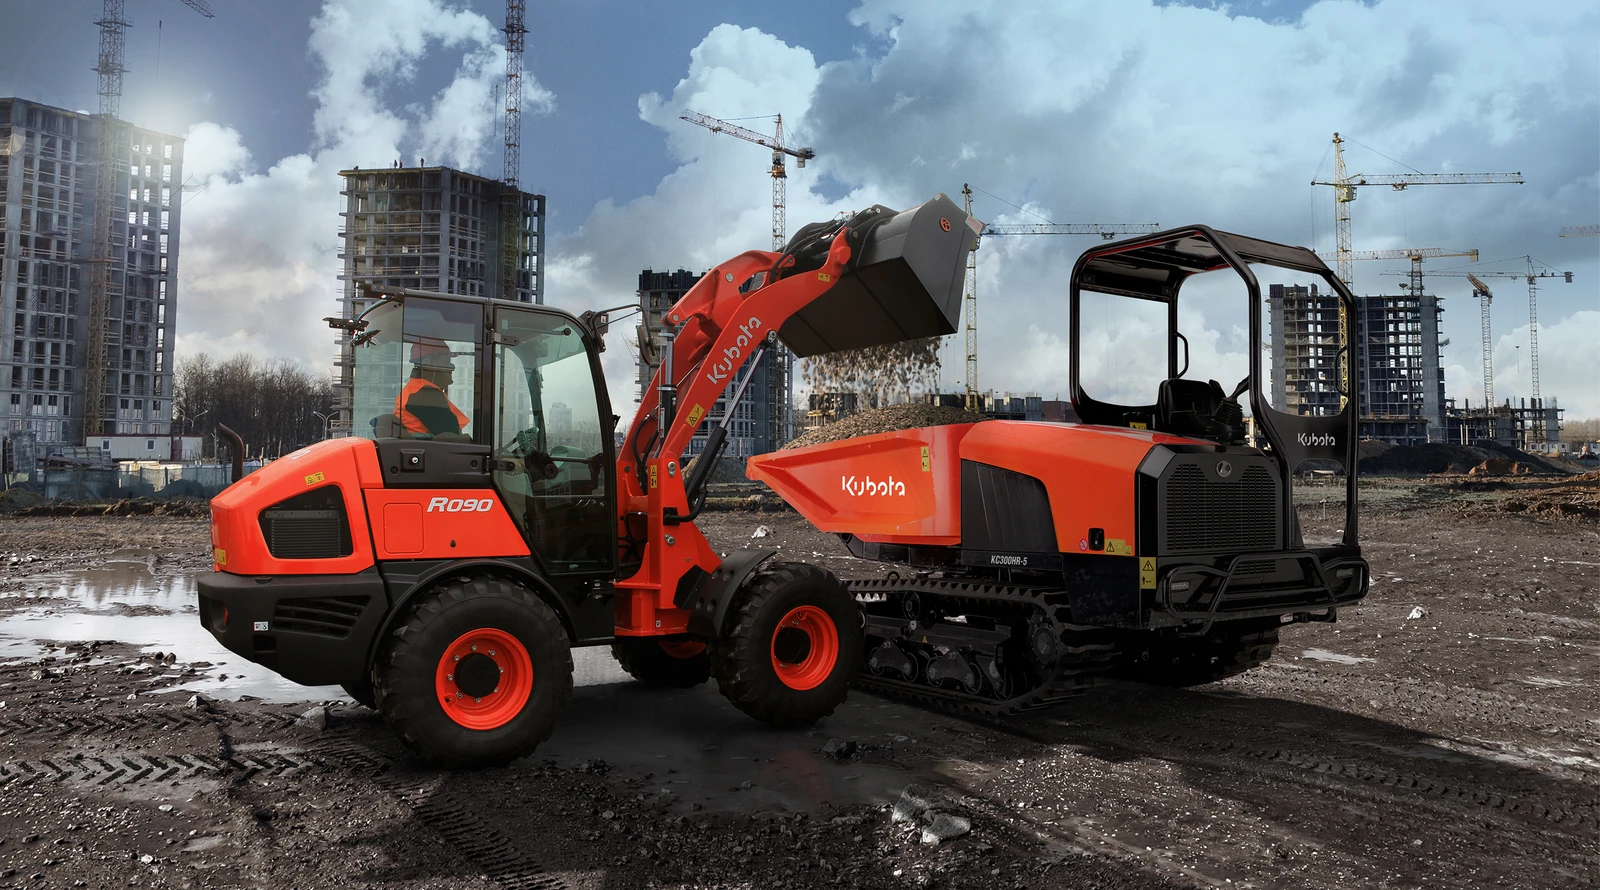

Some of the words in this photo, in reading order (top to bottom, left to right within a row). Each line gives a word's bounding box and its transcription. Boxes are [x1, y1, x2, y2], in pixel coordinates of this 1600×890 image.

[706, 316, 762, 385] Kubota
[1297, 432, 1336, 446] Kubota
[841, 475, 906, 497] Kubota
[990, 554, 1028, 566] KC300HR-5
